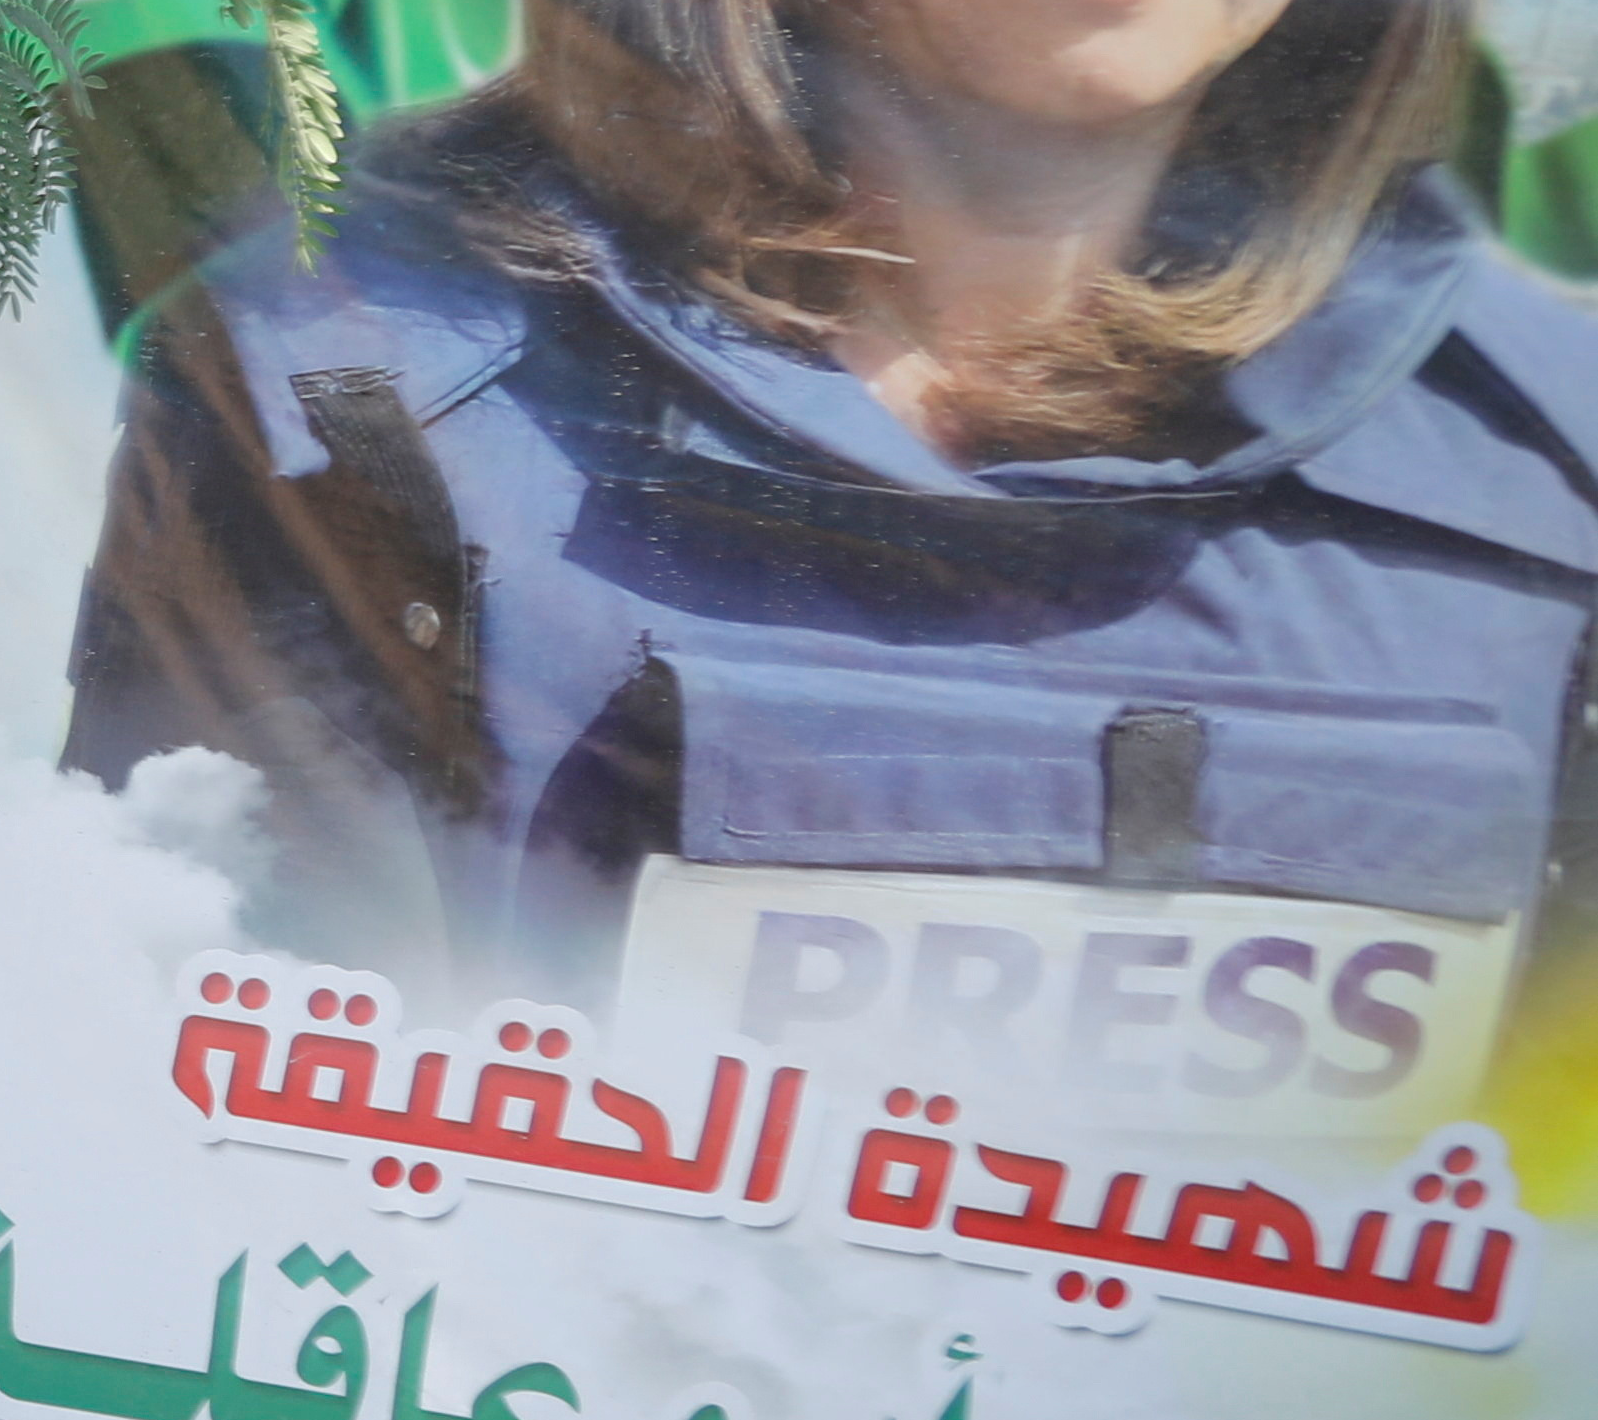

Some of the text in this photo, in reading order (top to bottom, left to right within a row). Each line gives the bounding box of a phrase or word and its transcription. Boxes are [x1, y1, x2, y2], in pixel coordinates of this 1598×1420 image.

[739, 908, 1441, 1098] PRESS
[171, 970, 1517, 1329] شهيدة الحقيقة
